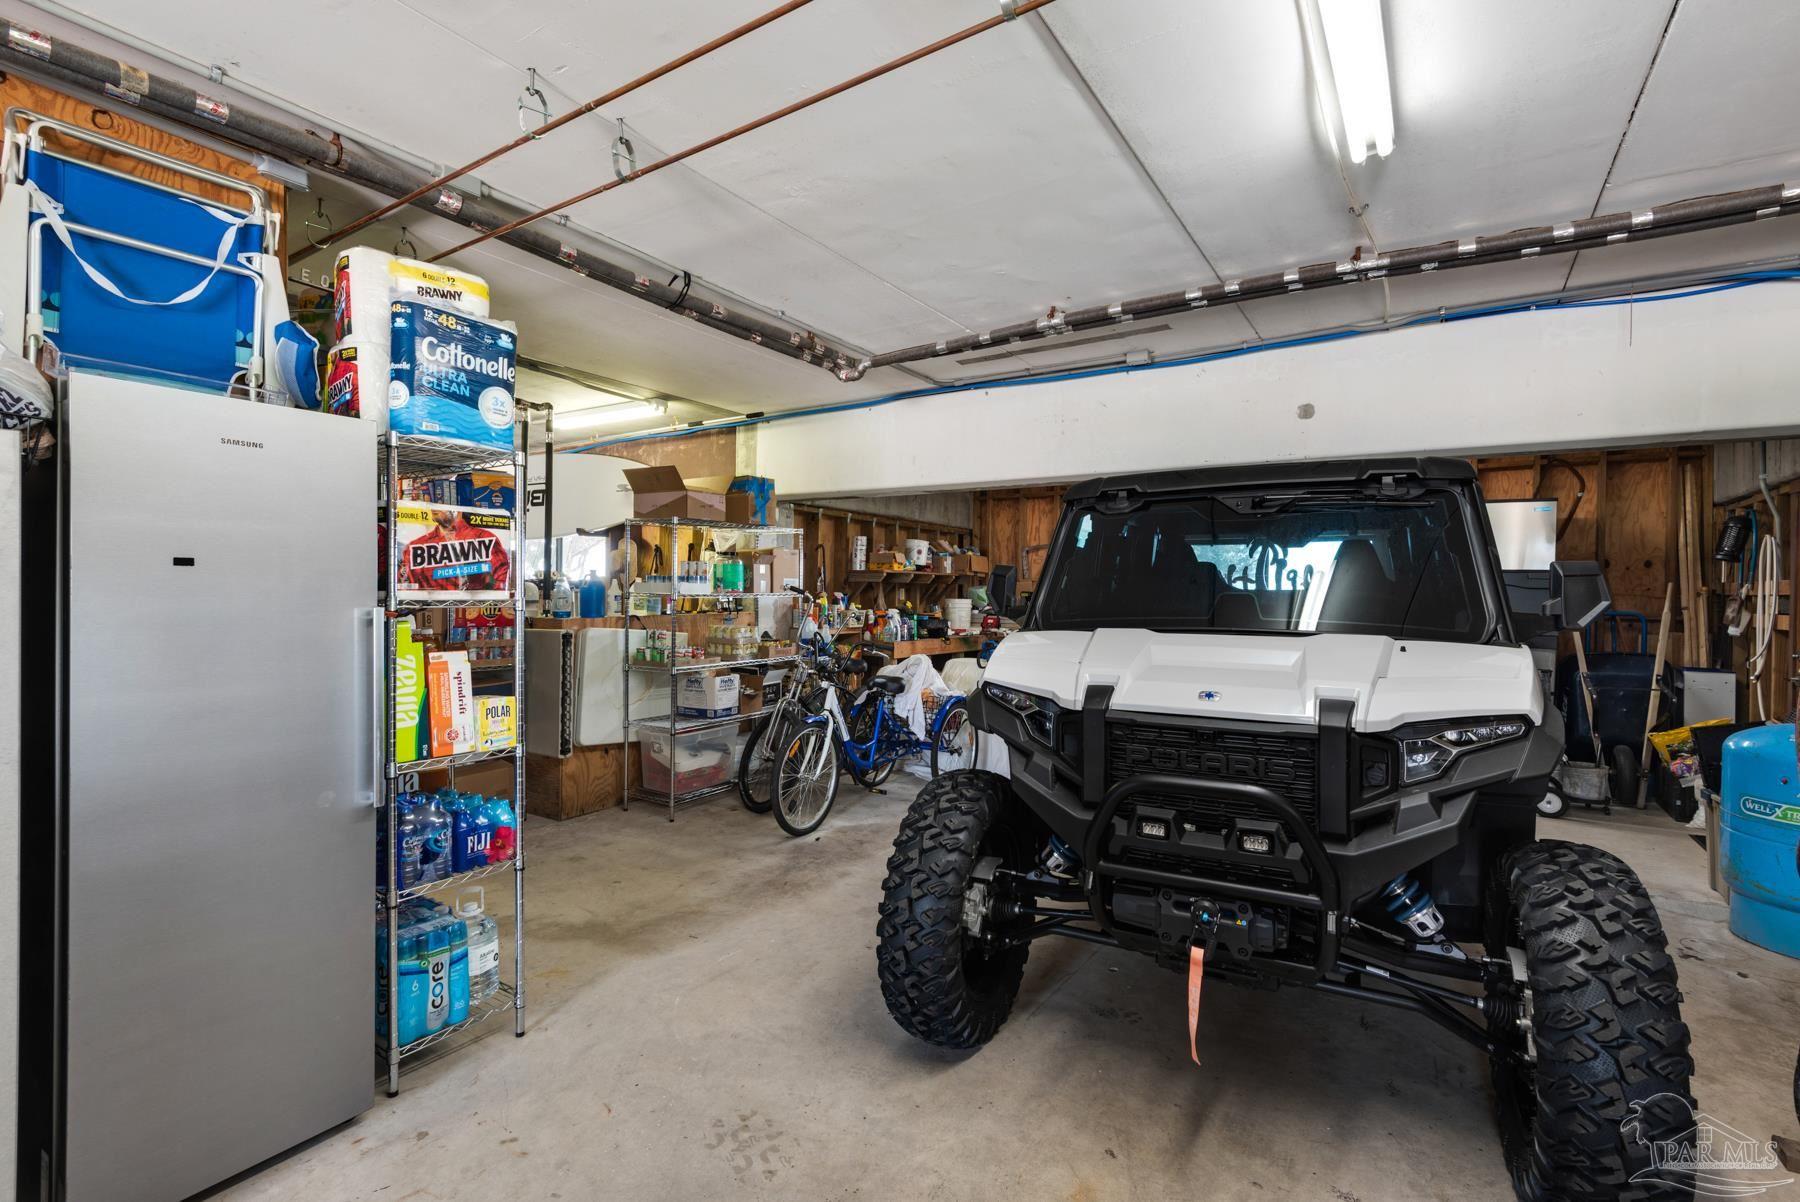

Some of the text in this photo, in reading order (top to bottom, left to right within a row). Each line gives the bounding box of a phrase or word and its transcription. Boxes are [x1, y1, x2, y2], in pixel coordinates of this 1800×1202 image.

[417, 286, 463, 302] BRAWNY
[438, 313, 456, 330] 48
[421, 336, 516, 383] Cottonelle
[422, 363, 468, 384] ULTRA
[422, 376, 470, 398] CLEAN
[220, 437, 264, 449] SAMSUNG
[421, 511, 429, 521] 12
[470, 515, 482, 525] 2X
[411, 539, 495, 569] BRAWNY
[453, 671, 468, 715] spindrift
[485, 705, 511, 720] POLAR
[1126, 745, 1297, 780] POLARIS
[466, 831, 491, 854] FIJI
[431, 960, 444, 1009] core
